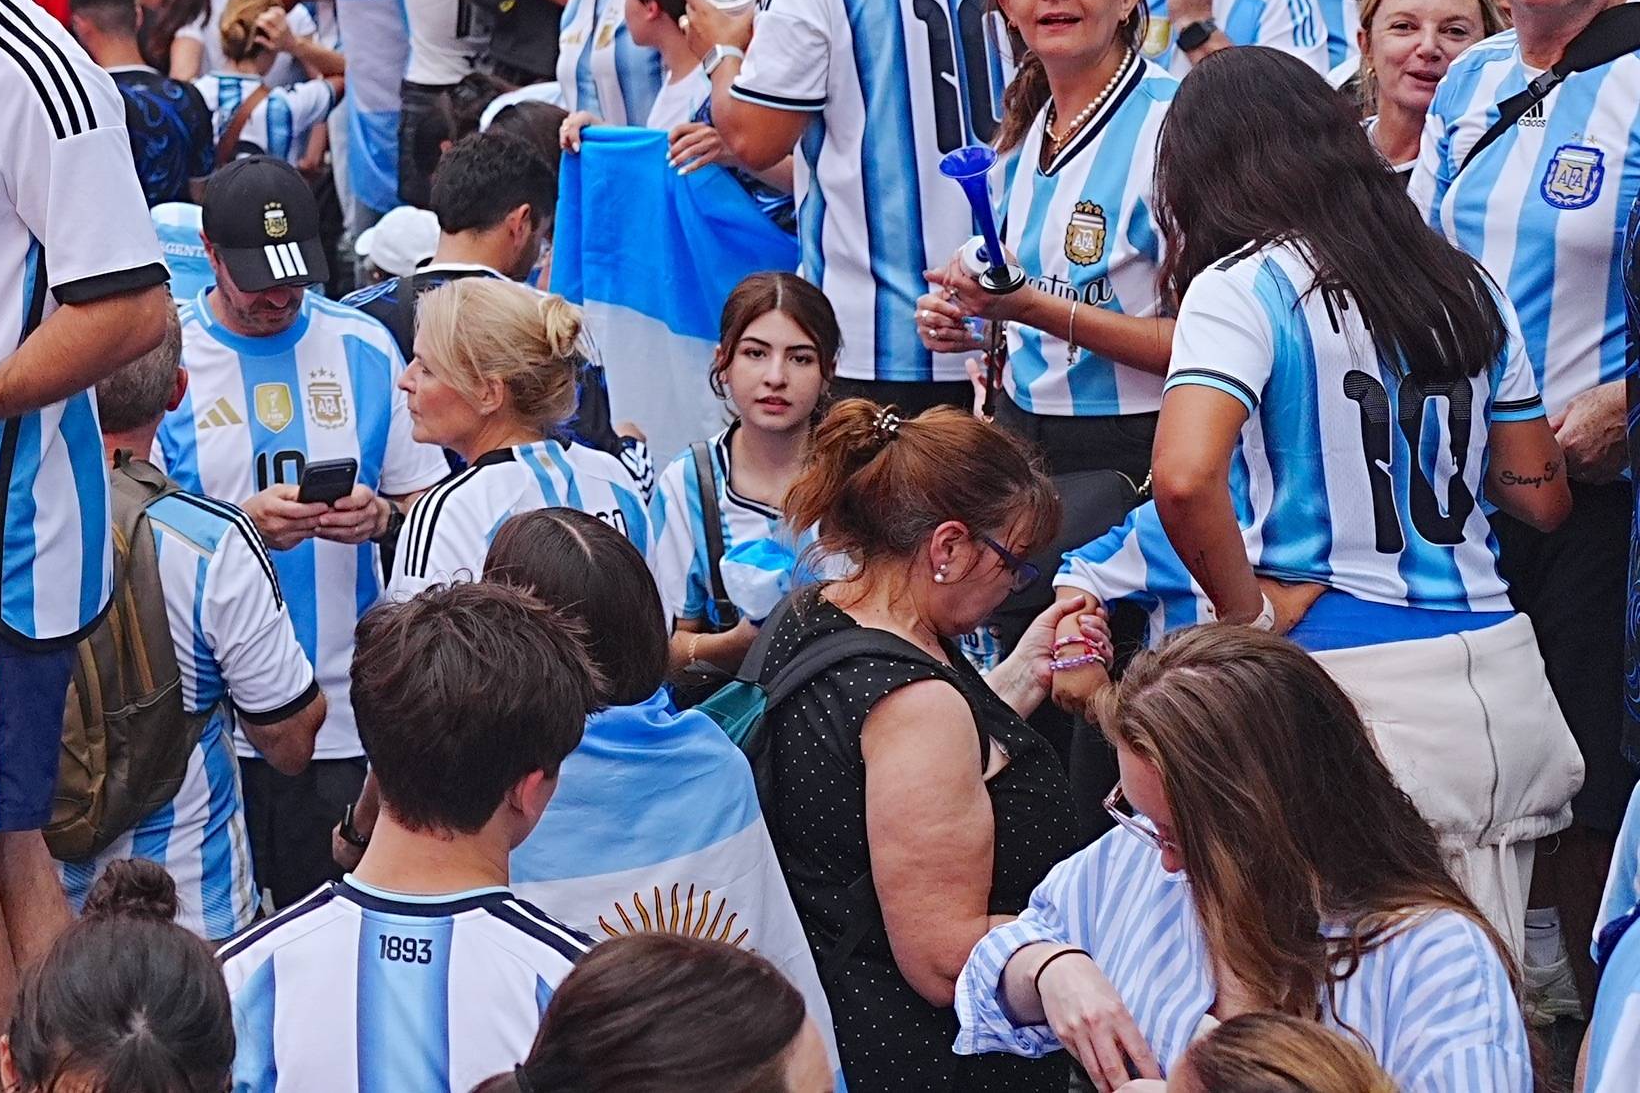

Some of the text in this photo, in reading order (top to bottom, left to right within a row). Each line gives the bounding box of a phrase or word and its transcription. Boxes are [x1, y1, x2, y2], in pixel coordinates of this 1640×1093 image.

[1556, 163, 1584, 191] AFA
[1342, 368, 1475, 555] 10
[378, 933, 433, 965] 1893
